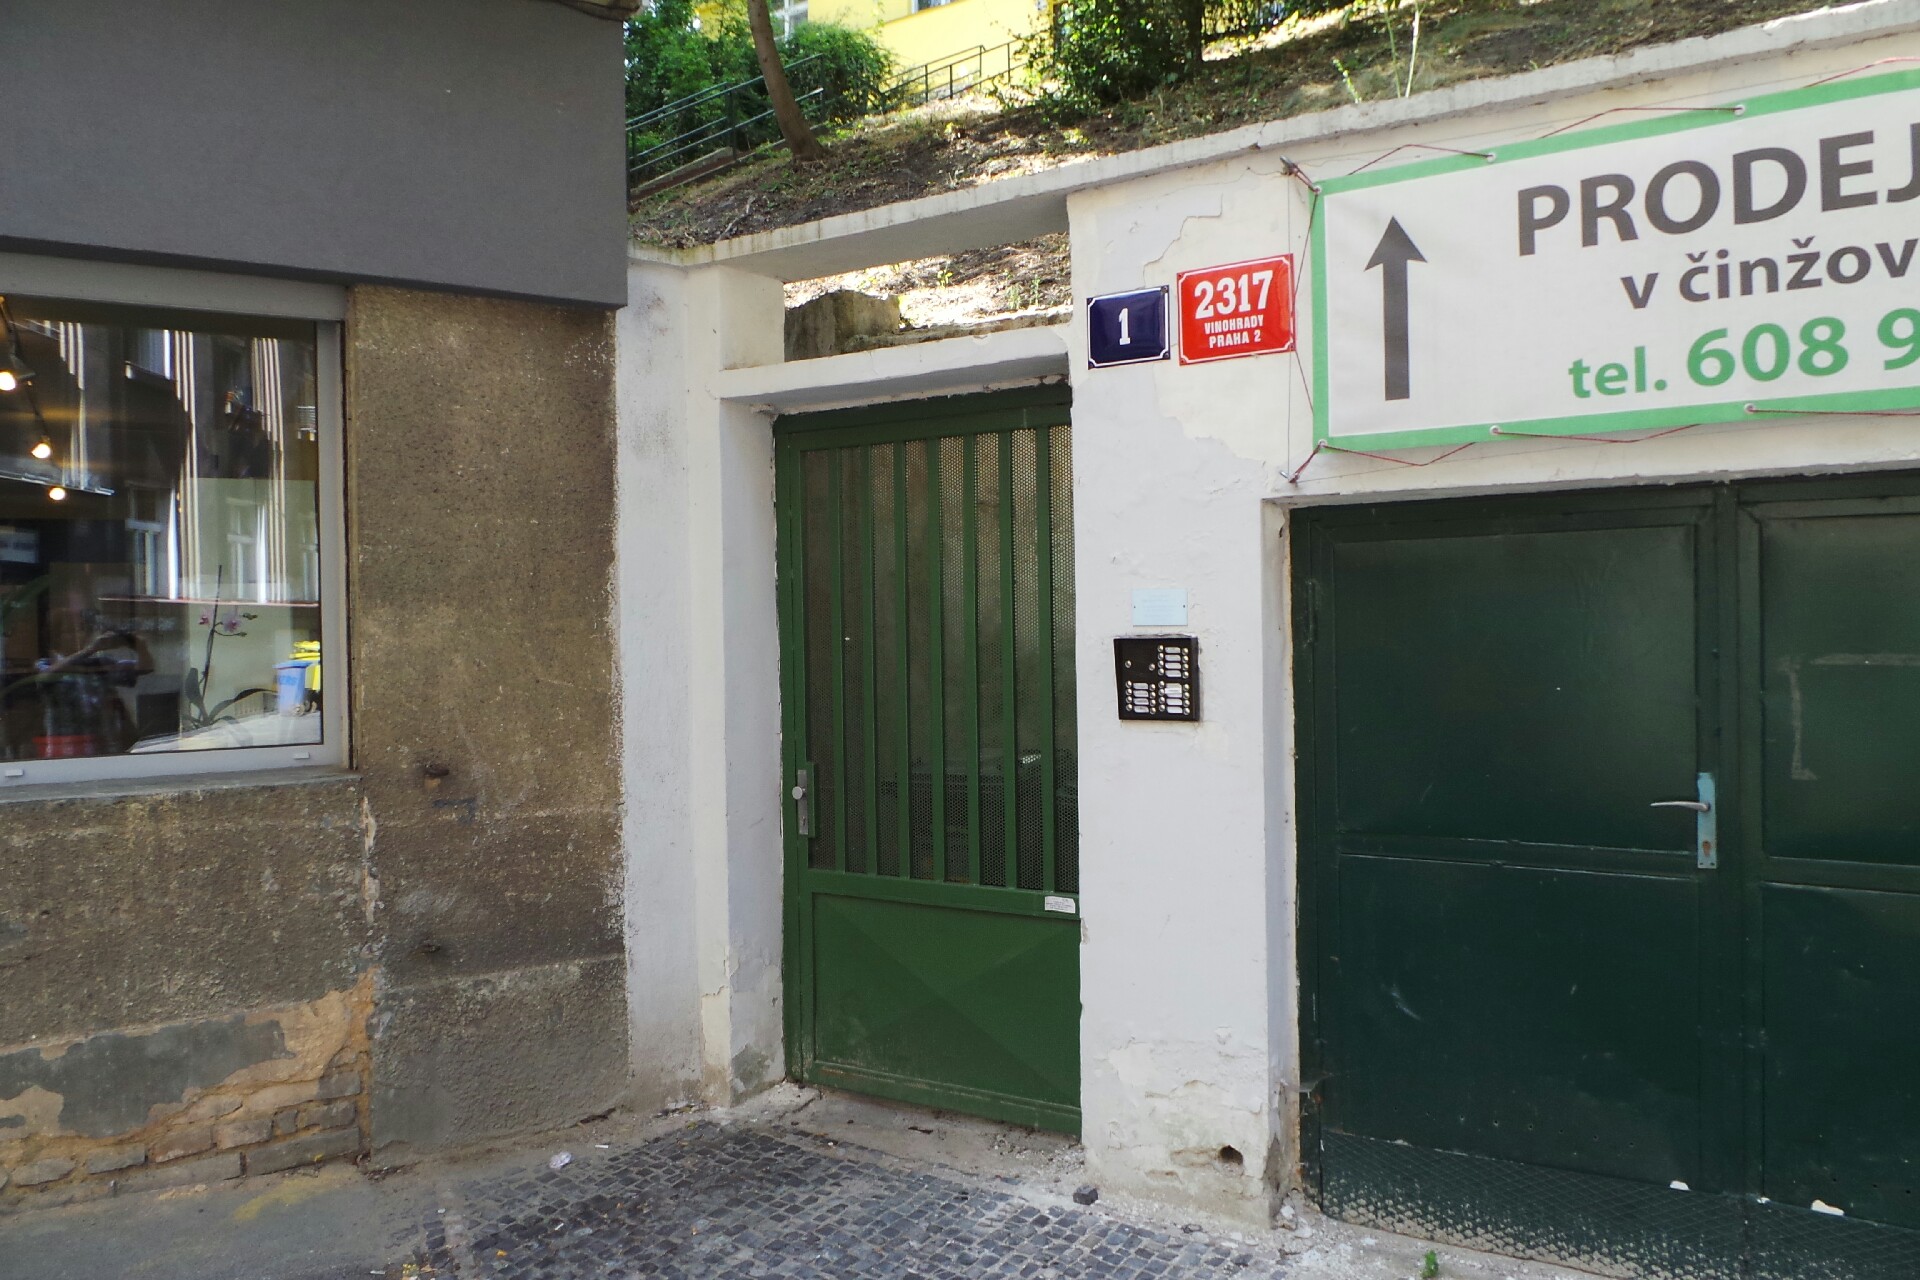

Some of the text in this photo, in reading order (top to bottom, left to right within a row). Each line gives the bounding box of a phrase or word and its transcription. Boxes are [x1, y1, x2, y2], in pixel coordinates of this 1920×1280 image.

[1517, 122, 1920, 257] PRODEJ
[1194, 269, 1274, 320] 2317
[1620, 236, 1919, 309] v činžov
[1118, 307, 1131, 346] 1
[1204, 314, 1264, 335] VINOHRADY
[1209, 330, 1262, 349] PRAHA 2
[1568, 307, 1920, 399] tel. 608 9
